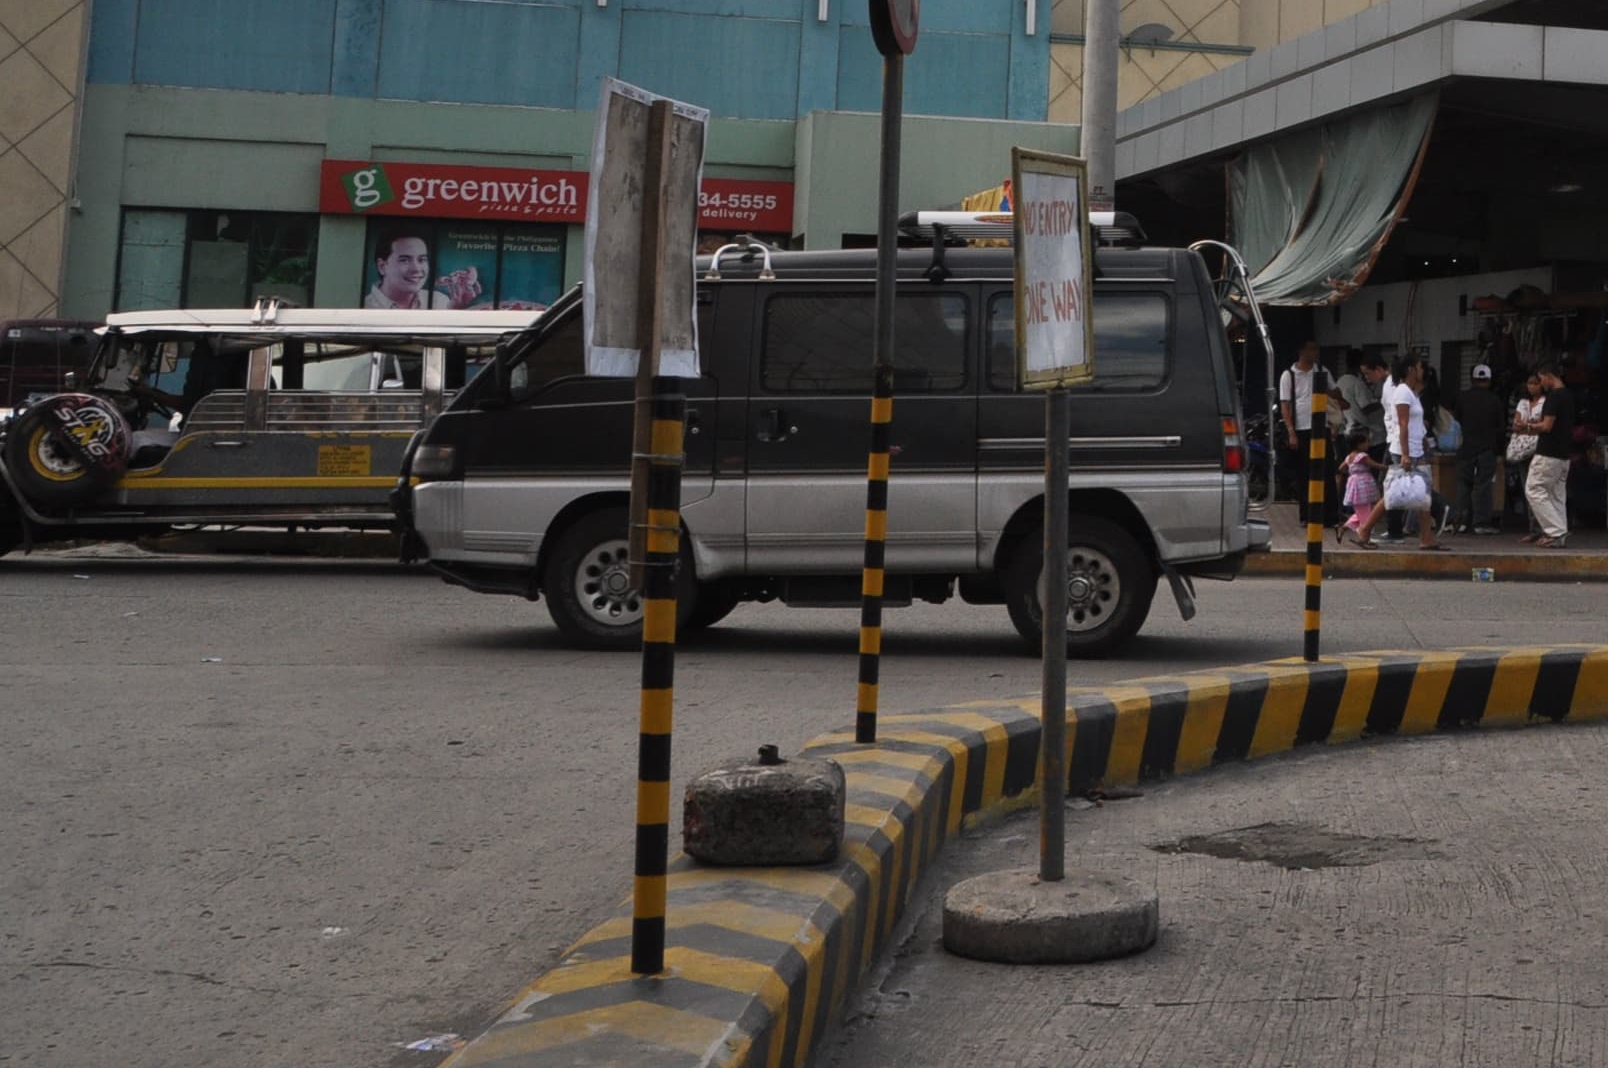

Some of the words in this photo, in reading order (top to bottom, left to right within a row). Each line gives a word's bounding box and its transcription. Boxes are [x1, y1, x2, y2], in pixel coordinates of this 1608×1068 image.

[352, 167, 381, 208] g
[401, 173, 578, 209] greenwich
[702, 208, 757, 221] delivery
[1023, 202, 1036, 236] NO
[1038, 200, 1075, 236] ENTRY
[456, 241, 497, 251] Favorite
[503, 243, 528, 252] Pizza
[1025, 281, 1049, 324] ONE
[1051, 278, 1082, 323] WAY
